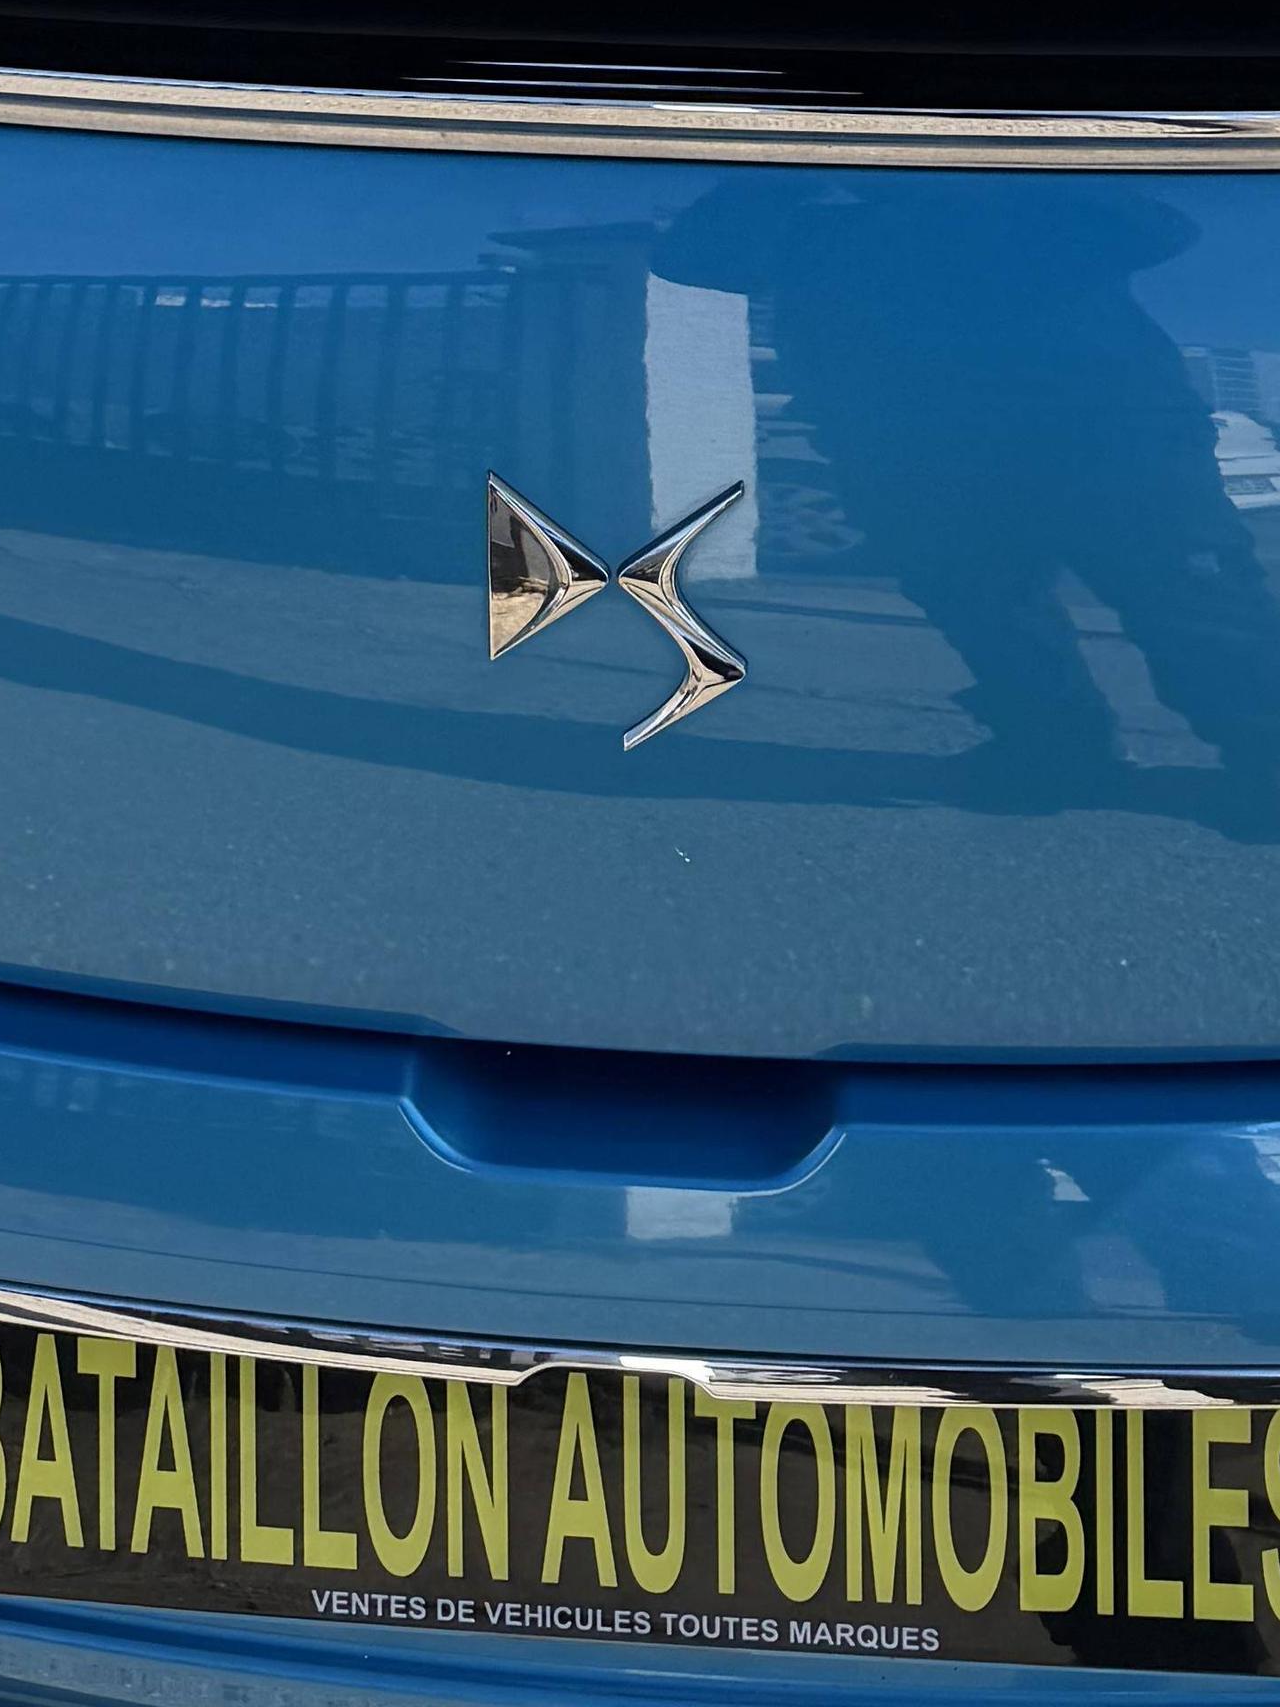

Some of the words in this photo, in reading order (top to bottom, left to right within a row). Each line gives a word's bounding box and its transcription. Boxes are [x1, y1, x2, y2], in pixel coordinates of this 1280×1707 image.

[311, 1589, 427, 1621] VENTES
[436, 1598, 476, 1624] DE
[485, 1601, 651, 1635] VEHICULES
[661, 1612, 779, 1643] TOUTES
[788, 1621, 940, 1653] MARQUES
